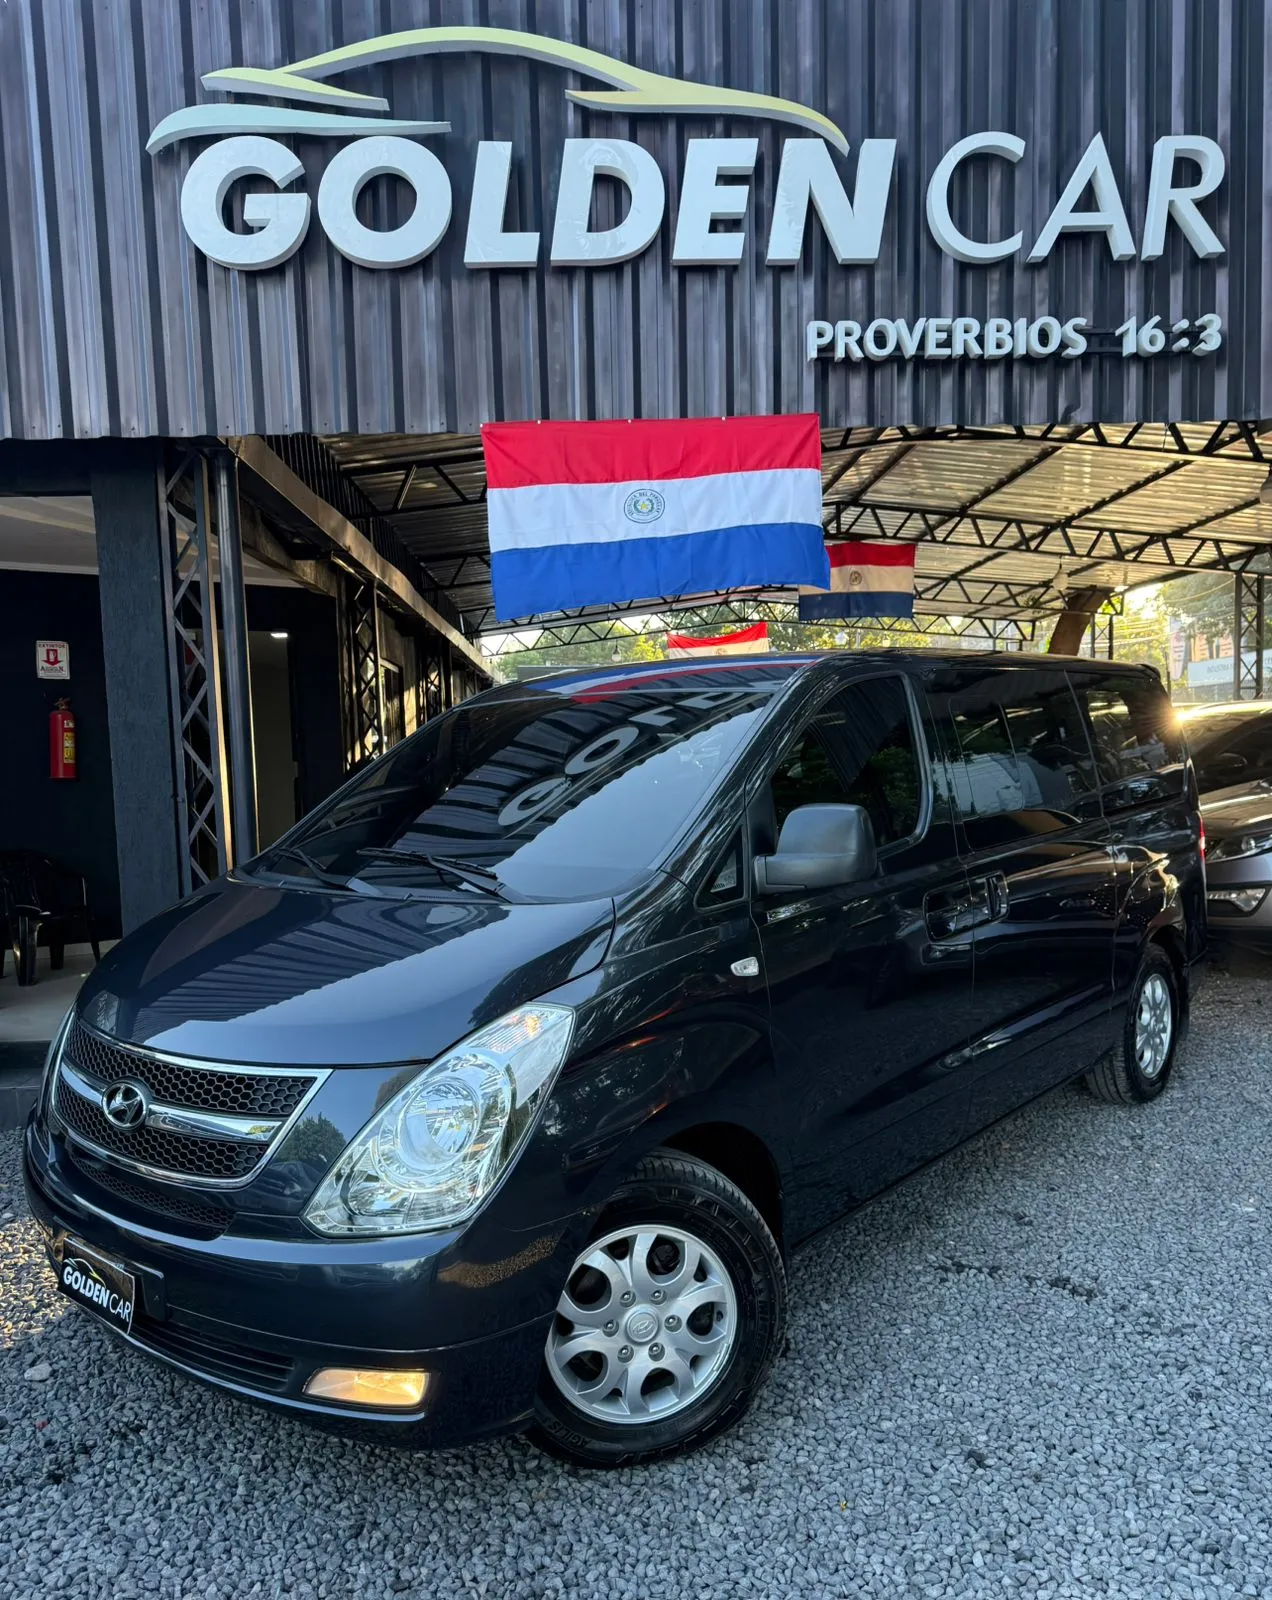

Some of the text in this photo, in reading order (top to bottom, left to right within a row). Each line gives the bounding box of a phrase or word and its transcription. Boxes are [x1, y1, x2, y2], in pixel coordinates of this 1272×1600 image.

[180, 131, 1227, 270] GOLDEN CAR
[806, 313, 1223, 363] PROVERBIOS 16:3
[63, 1266, 131, 1322] GOLDEN CAR
